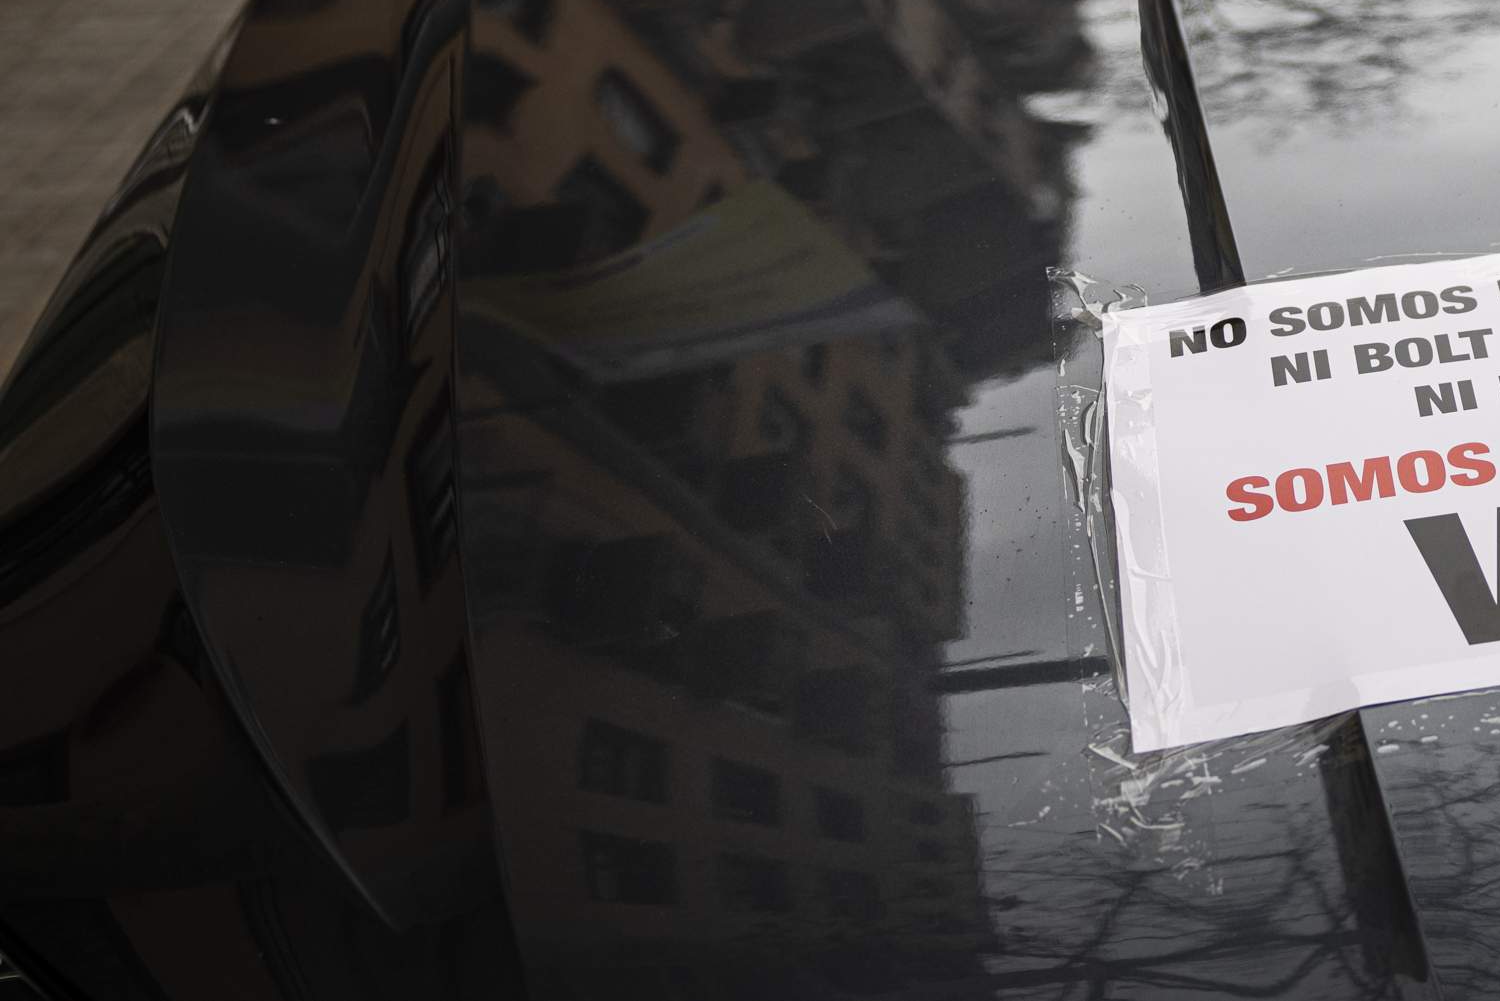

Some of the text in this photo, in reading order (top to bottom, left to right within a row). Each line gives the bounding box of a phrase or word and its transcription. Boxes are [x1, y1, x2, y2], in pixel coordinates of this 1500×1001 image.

[1168, 317, 1248, 359] NO
[1269, 285, 1478, 338] SOMOS
[1269, 348, 1333, 388] NI
[1353, 327, 1493, 376] BOLT
[1414, 378, 1479, 419] NI
[1225, 442, 1498, 523] SOMOS
